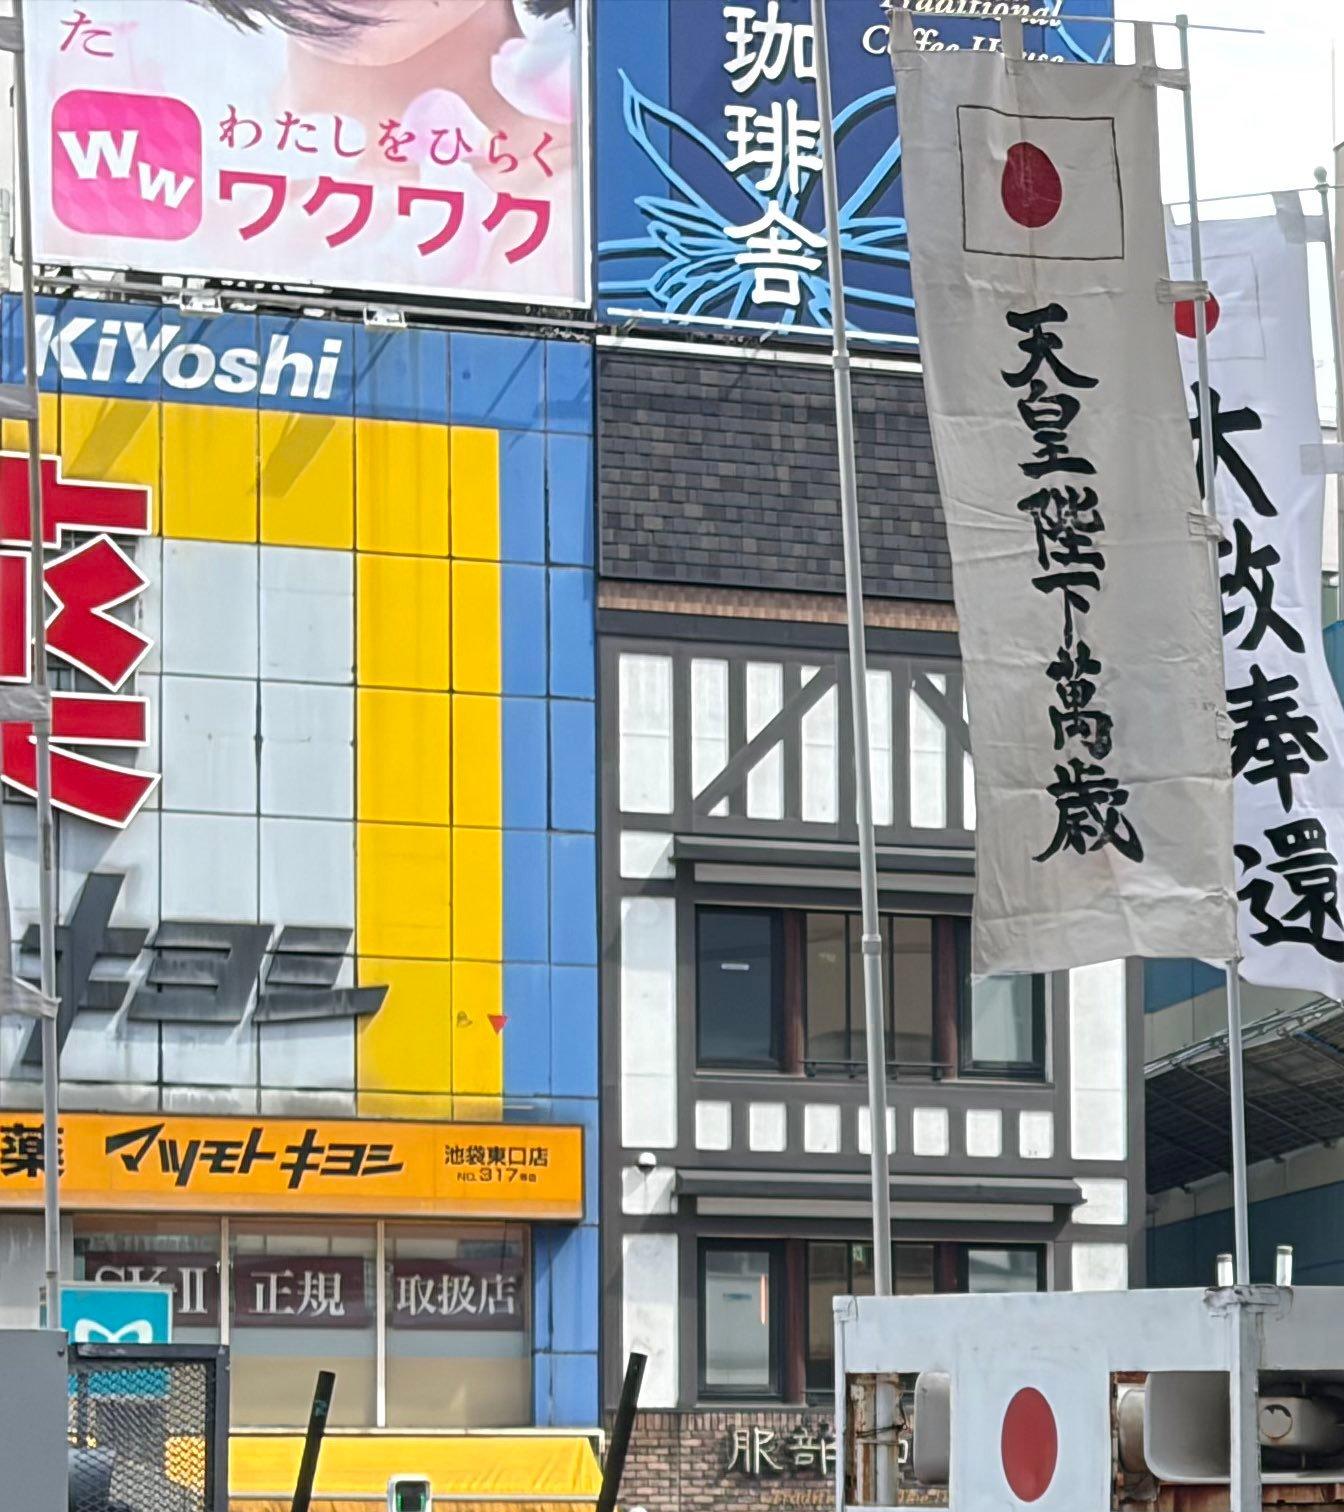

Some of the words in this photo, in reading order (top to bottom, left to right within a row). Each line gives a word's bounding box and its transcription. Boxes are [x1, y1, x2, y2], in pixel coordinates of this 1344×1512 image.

[862, 24, 960, 55] Cffee
[219, 105, 556, 178] わたしをひらく
[219, 169, 552, 264] ワクワク
[1001, 301, 1144, 864] 天皇陛下萬歳
[105, 1122, 405, 1189] マツモトキヨシ
[445, 1144, 549, 1167] 池袋東口店
[249, 1270, 346, 1317] 正規
[397, 1272, 516, 1317] 取扱店
